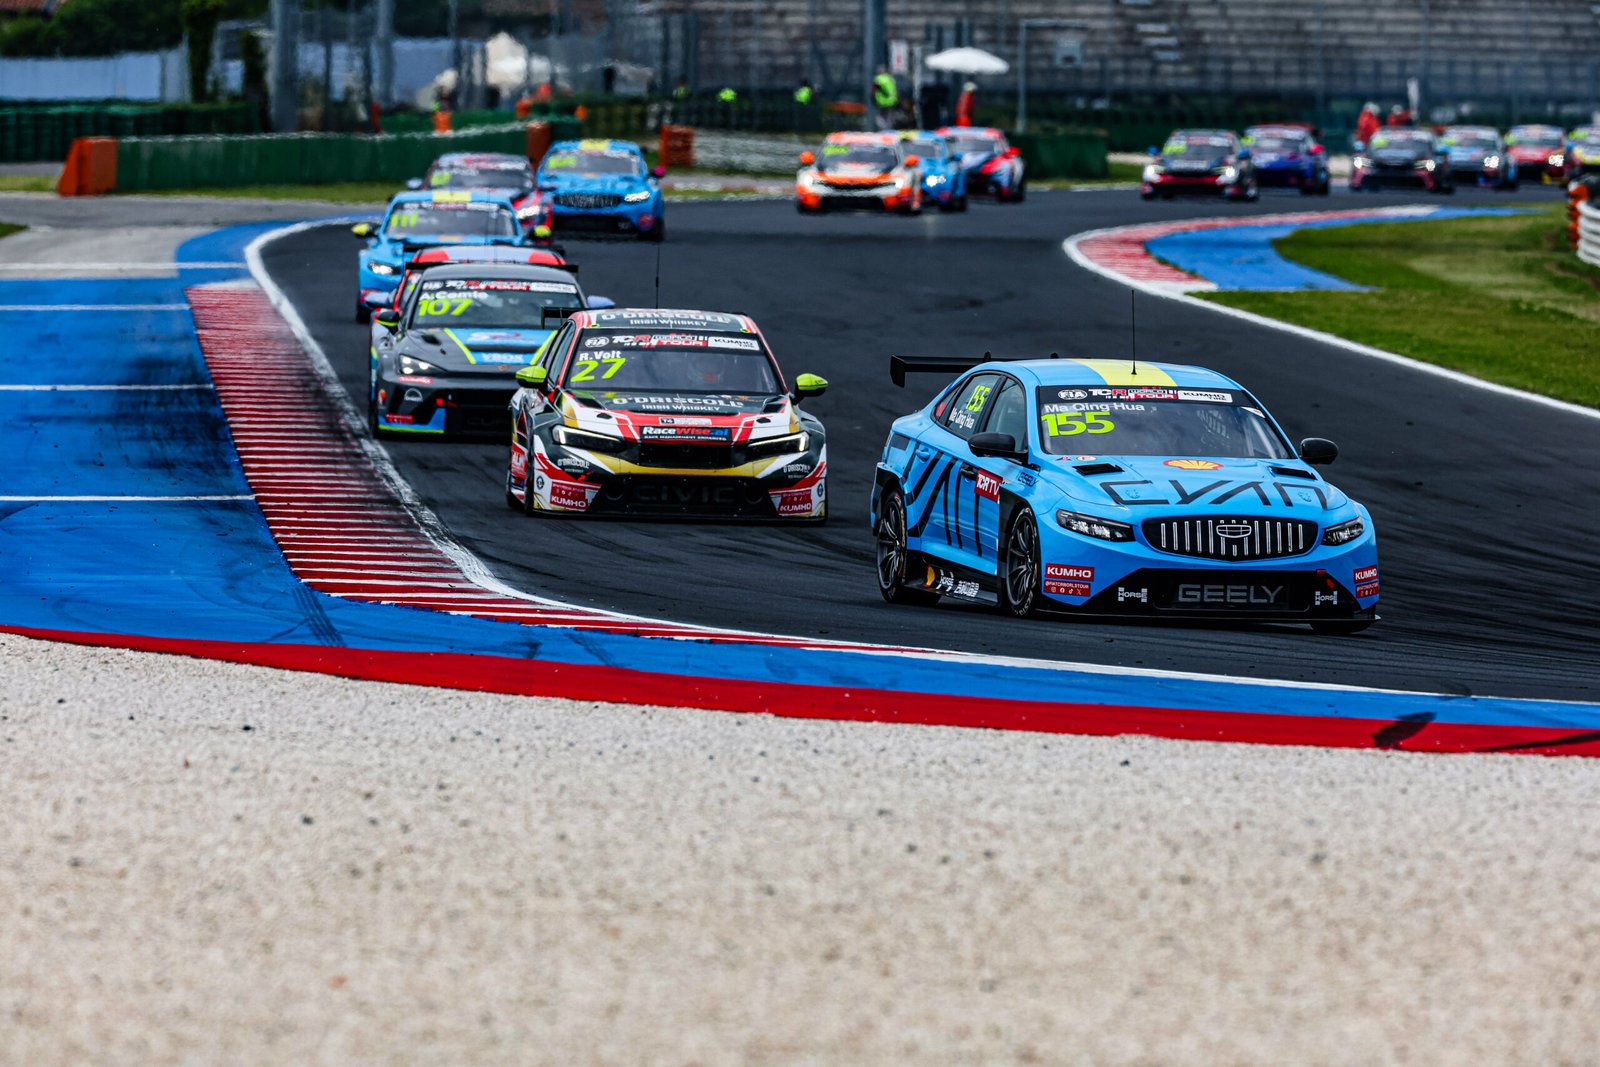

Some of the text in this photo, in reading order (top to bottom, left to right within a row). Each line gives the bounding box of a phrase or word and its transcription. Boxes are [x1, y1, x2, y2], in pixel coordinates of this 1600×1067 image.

[418, 298, 472, 316] 107
[663, 319, 708, 327] WHISKEY
[585, 337, 609, 347] FIA
[570, 357, 626, 382] 27
[966, 385, 991, 413] 155
[1058, 389, 1088, 400] FIA
[1043, 402, 1146, 413] Ma Qing Hua
[1041, 411, 1115, 437] 155
[1100, 479, 1328, 510] CYAN
[551, 496, 586, 508] KUMHO
[780, 503, 812, 511] KUMHO
[1047, 566, 1092, 578] KUMHO
[1355, 568, 1377, 580] KUMHO
[1117, 586, 1148, 603] HORSE
[1178, 583, 1284, 604] GEELY
[1314, 590, 1338, 606] HORSE
